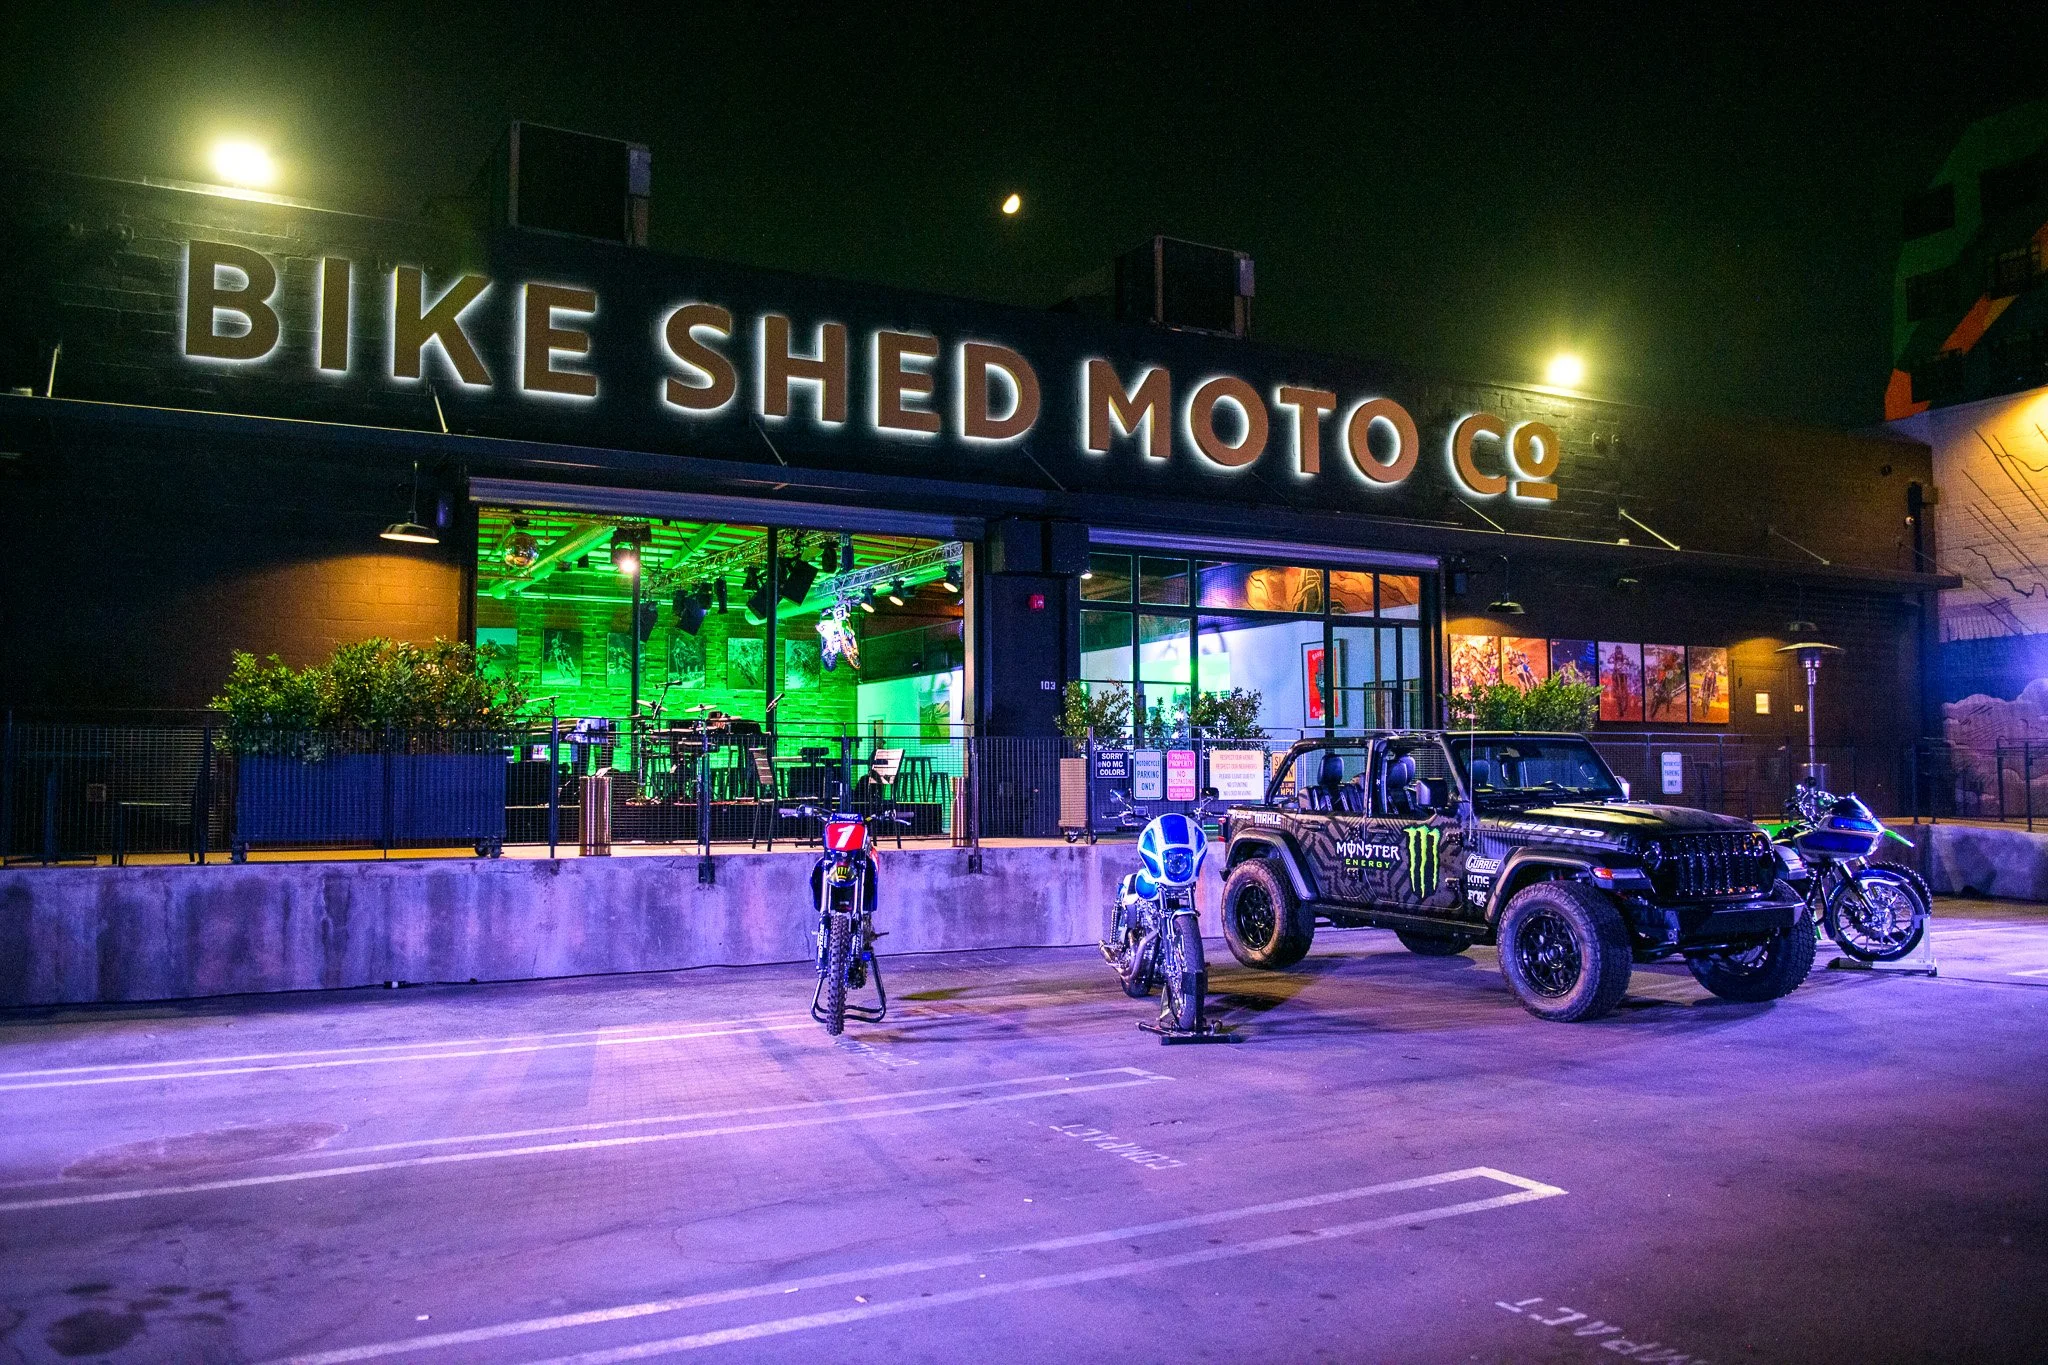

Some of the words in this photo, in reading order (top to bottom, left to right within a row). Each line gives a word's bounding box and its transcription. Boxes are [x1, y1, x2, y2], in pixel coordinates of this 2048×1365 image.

[184, 238, 599, 401] BIKE
[661, 301, 1041, 443] SHED
[1084, 358, 1419, 484] MOTO
[1040, 680, 1056, 690] 103
[1101, 752, 1124, 760] SORRY
[1101, 760, 1112, 768] NO
[1112, 760, 1124, 768] MC
[1099, 768, 1126, 776] COLORS
[1136, 770, 1160, 779] PARKING
[1176, 770, 1186, 778] NO
[1141, 782, 1155, 791] ONLY
[1280, 788, 1294, 796] MPH
[1254, 814, 1282, 825] MAHLE
[1336, 840, 1400, 860] MONSTER
[1345, 859, 1391, 869] ENERGY
[1467, 855, 1500, 870] CURRIE
[1467, 874, 1490, 884] KMC
[1467, 889, 1487, 906] FOX
